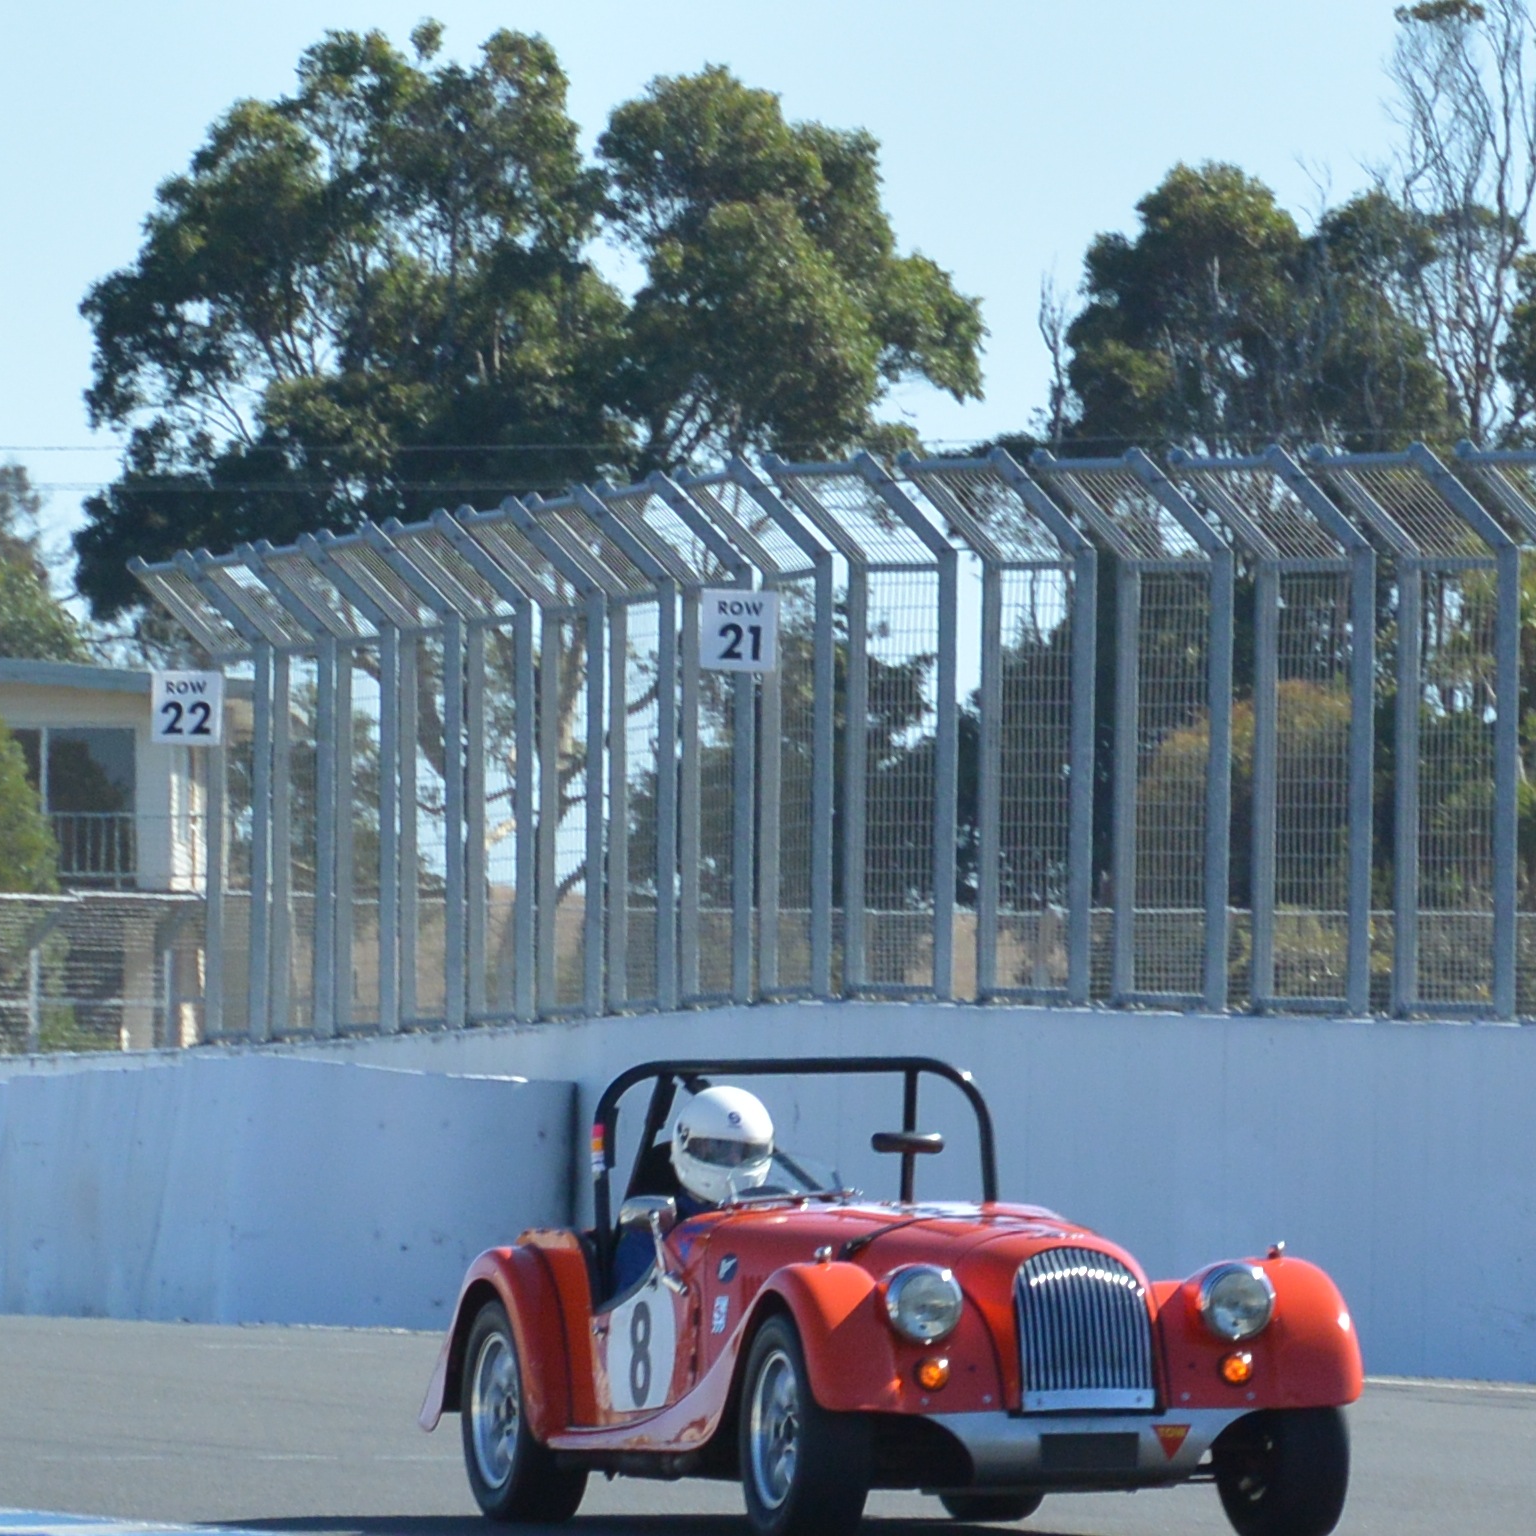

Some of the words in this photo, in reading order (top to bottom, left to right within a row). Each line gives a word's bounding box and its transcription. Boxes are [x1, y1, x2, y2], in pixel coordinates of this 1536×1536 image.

[718, 600, 764, 616] ROW
[718, 623, 762, 661] 21
[165, 681, 207, 695] ROW
[161, 701, 211, 735] 22
[630, 1301, 651, 1408] 8
